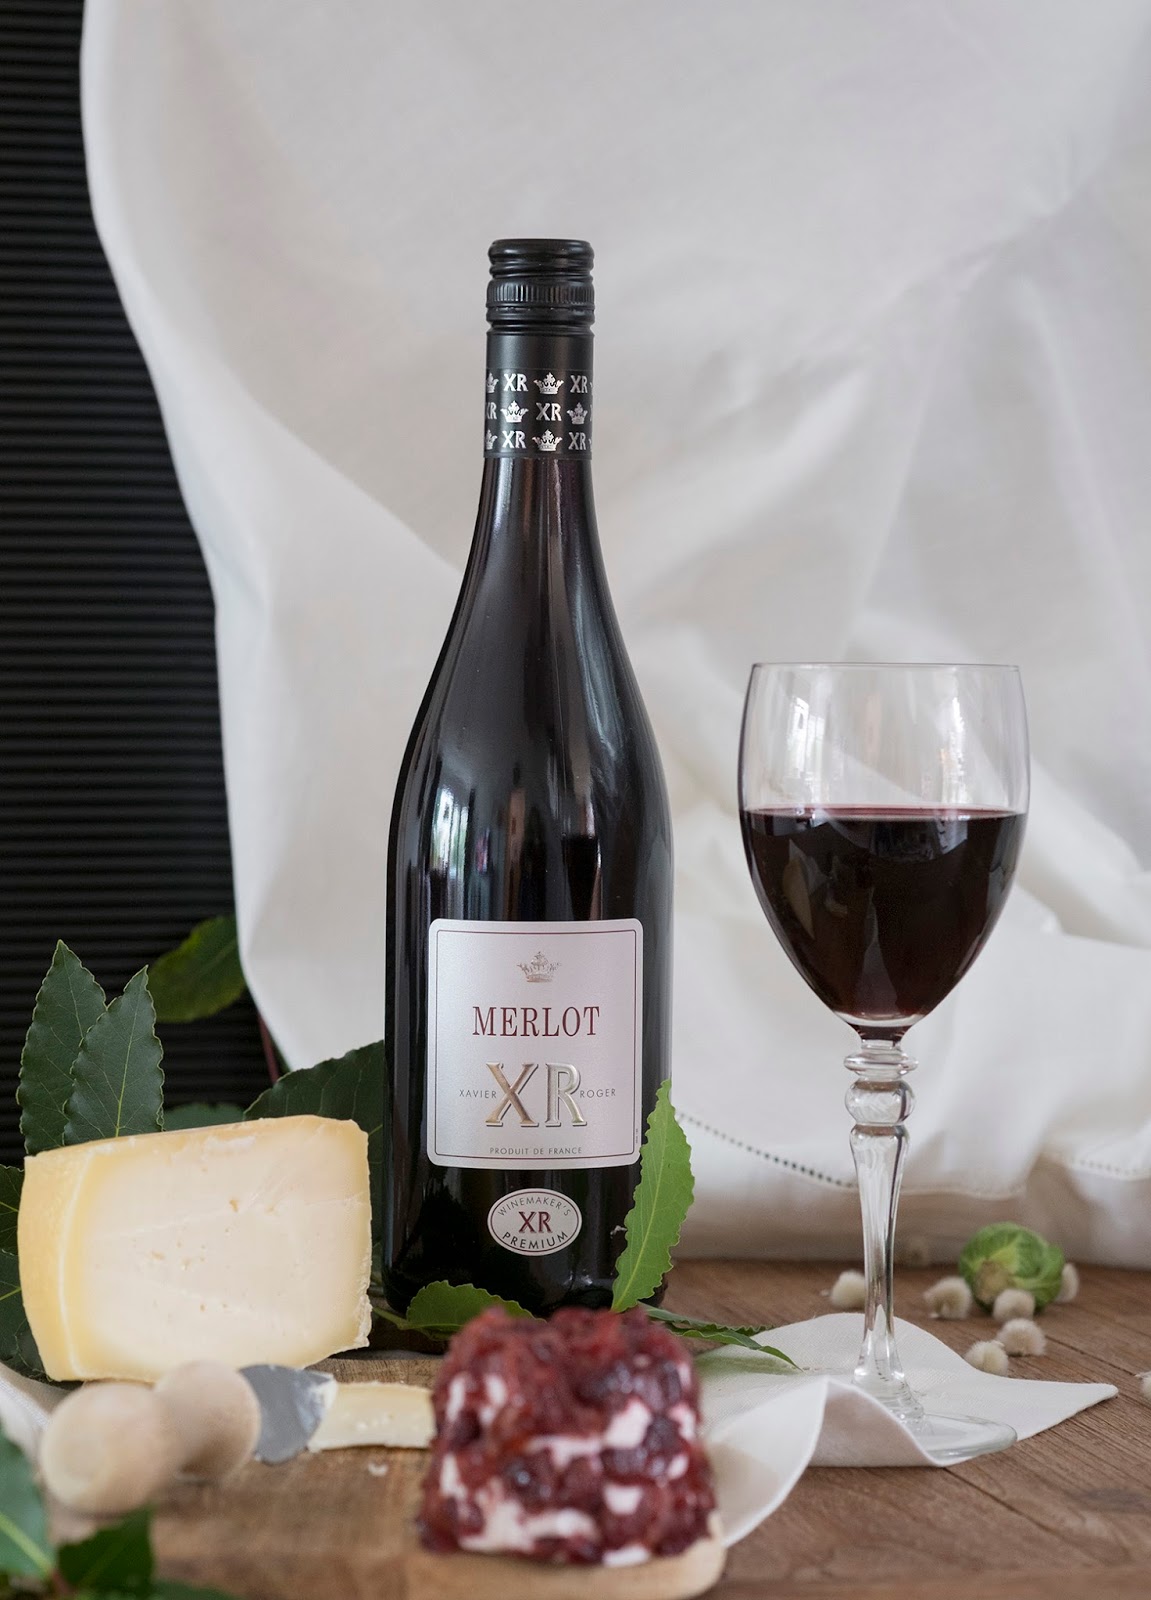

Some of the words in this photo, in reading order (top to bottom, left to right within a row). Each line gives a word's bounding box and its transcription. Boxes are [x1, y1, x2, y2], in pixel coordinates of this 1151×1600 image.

[503, 373, 529, 392] XR
[570, 374, 588, 394] XR
[535, 402, 562, 422] XR
[502, 430, 527, 449] XR
[568, 431, 587, 450] XR
[472, 1006, 600, 1037] MERLOT
[459, 1089, 497, 1099] XAVIER
[485, 1062, 588, 1127] XR
[579, 1088, 616, 1099] ROGER
[489, 1147, 529, 1155] PRODUIT
[533, 1147, 545, 1155] DE
[548, 1146, 582, 1155] FRANCE
[497, 1196, 571, 1217] WINEMAKER'S
[518, 1211, 553, 1233] XR
[502, 1231, 568, 1249] PREMIUM
